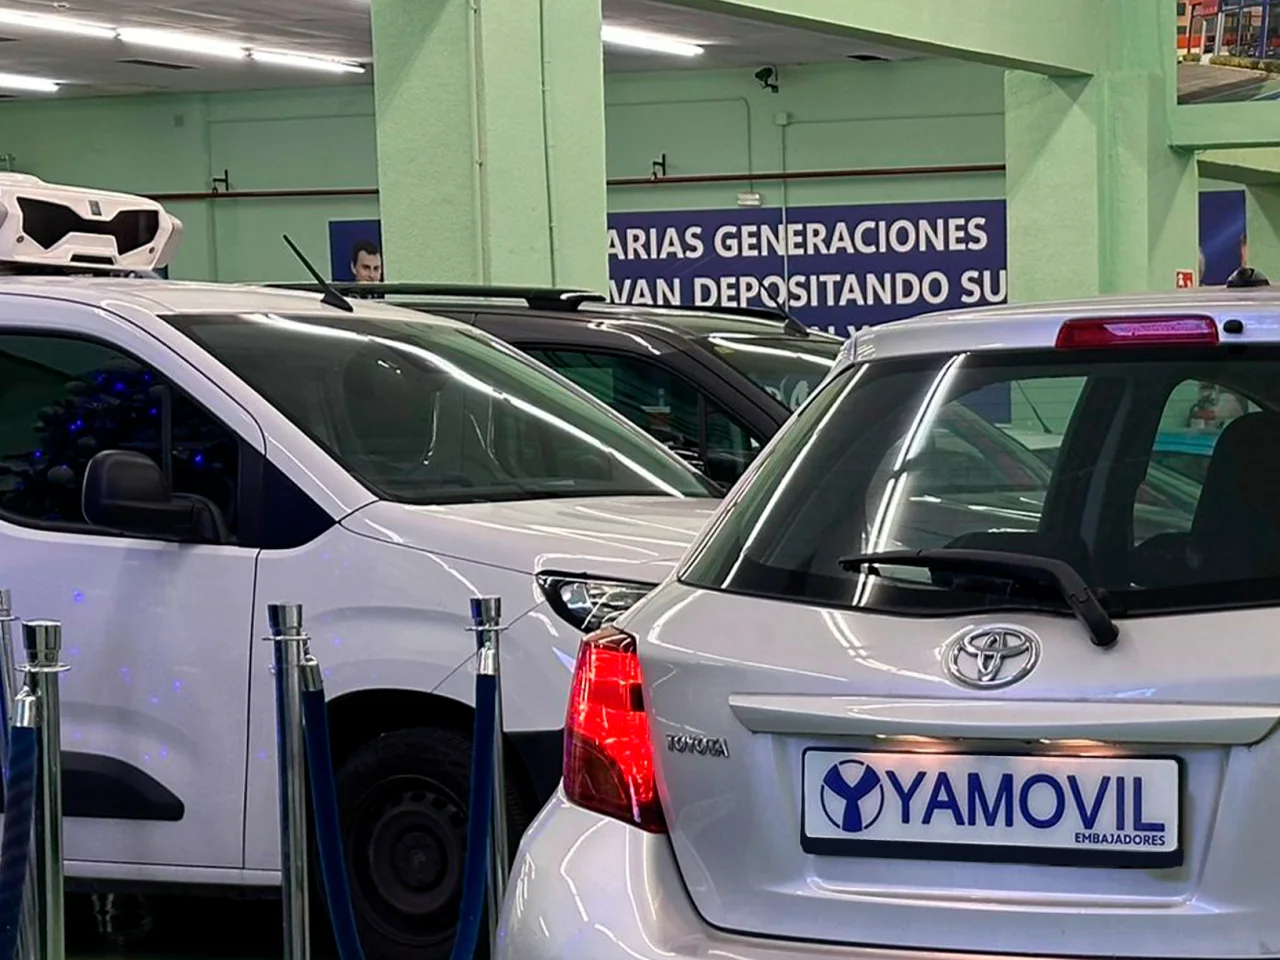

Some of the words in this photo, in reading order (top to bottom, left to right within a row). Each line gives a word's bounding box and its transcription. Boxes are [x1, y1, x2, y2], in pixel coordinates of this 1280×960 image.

[607, 225, 704, 260] ARIAS
[713, 216, 988, 258] GENERACIONES
[694, 270, 950, 307] DEPOSITANDO
[666, 733, 730, 759] TOYOTA
[884, 770, 1166, 832] YAMOVIL
[1074, 832, 1166, 847] EMBAJADORES
